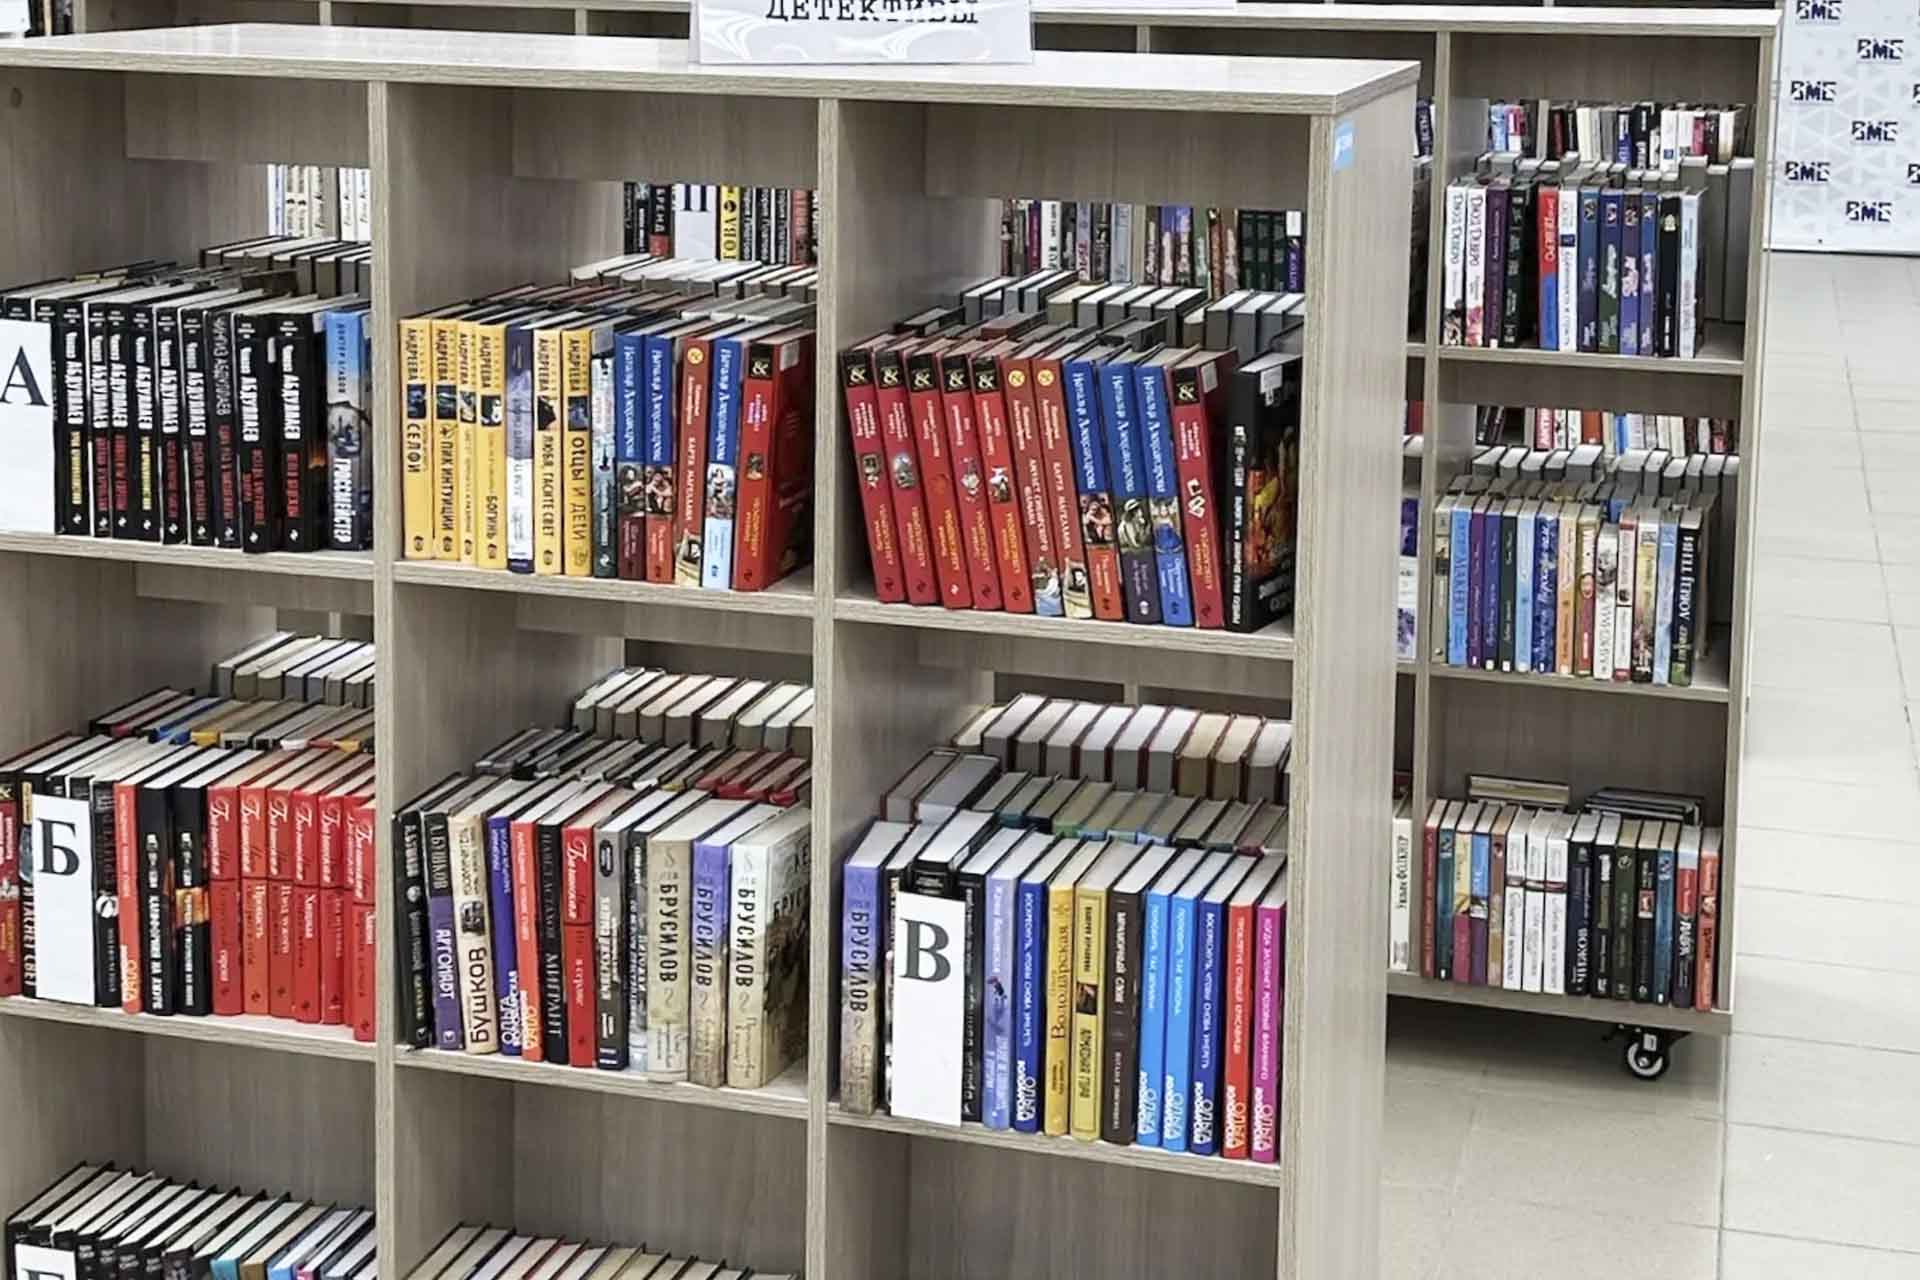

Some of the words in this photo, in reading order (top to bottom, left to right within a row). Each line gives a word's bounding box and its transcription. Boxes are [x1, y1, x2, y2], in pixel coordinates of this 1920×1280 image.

[766, 0, 978, 23] ДЕТЕКТИВЫ
[212, 317, 228, 356] ЧИНГИЗ
[406, 328, 418, 380] АНДРЕЕВА
[436, 329, 449, 382] АНДРЕЕВА
[458, 333, 470, 385] АНДРЕЕВА
[479, 336, 492, 389] АНДРЕЕВА
[538, 338, 550, 392] АНДРЕЕВА
[568, 339, 581, 391] АНДРЕЕВА
[0, 345, 49, 406] А
[64, 361, 84, 425] АБДУЛЛАЕВ
[90, 364, 108, 428] АБДУЛЛАЕВ
[109, 363, 127, 427] АБДУЛЛАЕВ
[136, 366, 152, 430] АБДУЛЛАЕВ
[160, 369, 178, 433] АБДУЛЛАЕВ
[186, 372, 205, 436] АБДУЛЛАЕВ
[212, 358, 230, 415] АБДУЛЛАЕВ
[240, 377, 259, 442] АБДУЛЛАЕВ
[282, 375, 301, 439] АБДУЛЛАЕВ
[623, 388, 637, 459] Александрова
[651, 392, 665, 462] Александрова
[716, 391, 730, 461] Александрова
[407, 424, 421, 473] СЕЛФИ
[440, 441, 454, 465] ПИК
[541, 435, 554, 470] ЛЮБЯ,
[686, 437, 697, 465] КАРТА
[1052, 461, 1063, 491] КАРТА
[1078, 417, 1096, 489] Александрова
[1116, 420, 1135, 493] Александрова
[1148, 421, 1167, 493] Александрова
[333, 457, 356, 543] ГРОССМЕЙСТЕР
[440, 467, 454, 531] ИНТУИЦИИ
[485, 496, 499, 540] БОГИНЬ
[542, 472, 555, 508] ГАСИТЕ
[572, 486, 586, 497] И
[685, 469, 697, 521] МАГЕЛЛАНА
[542, 509, 555, 537] СВЕТ
[1057, 495, 1072, 550] МАГЕЛЛАНА
[37, 817, 80, 876] Б
[541, 834, 553, 876] ПАВЕЛ
[149, 896, 161, 959] КАЛИФОРНИЯ
[543, 879, 556, 939] АСТАХОВ
[658, 884, 679, 983] БРУСИЛОВ
[695, 888, 713, 986] БРУСИЛОВ
[735, 888, 756, 987] БРУСИЛОВ
[1263, 917, 1273, 947] КОГДА
[151, 961, 162, 974] НА
[436, 928, 453, 1000] АРГОНАВТ
[849, 911, 871, 1012] БРУСИЛОВ
[900, 917, 952, 983] В
[469, 946, 491, 1044] БУШКОВ
[545, 952, 562, 1037] МИГРАНТ
[1050, 926, 1071, 1041] Володарская
[500, 998, 514, 1044] ОЛЬГА
[1025, 1077, 1037, 1120] ОЛЬГА
[1145, 1088, 1158, 1134] ОЛЬГА
[1172, 1091, 1184, 1139] ОЛЬГА
[1202, 1098, 1214, 1143] ОЛЬГА
[1235, 1101, 1247, 1148] ОЛЬГА
[1261, 1104, 1273, 1151] ОЛЬГА
